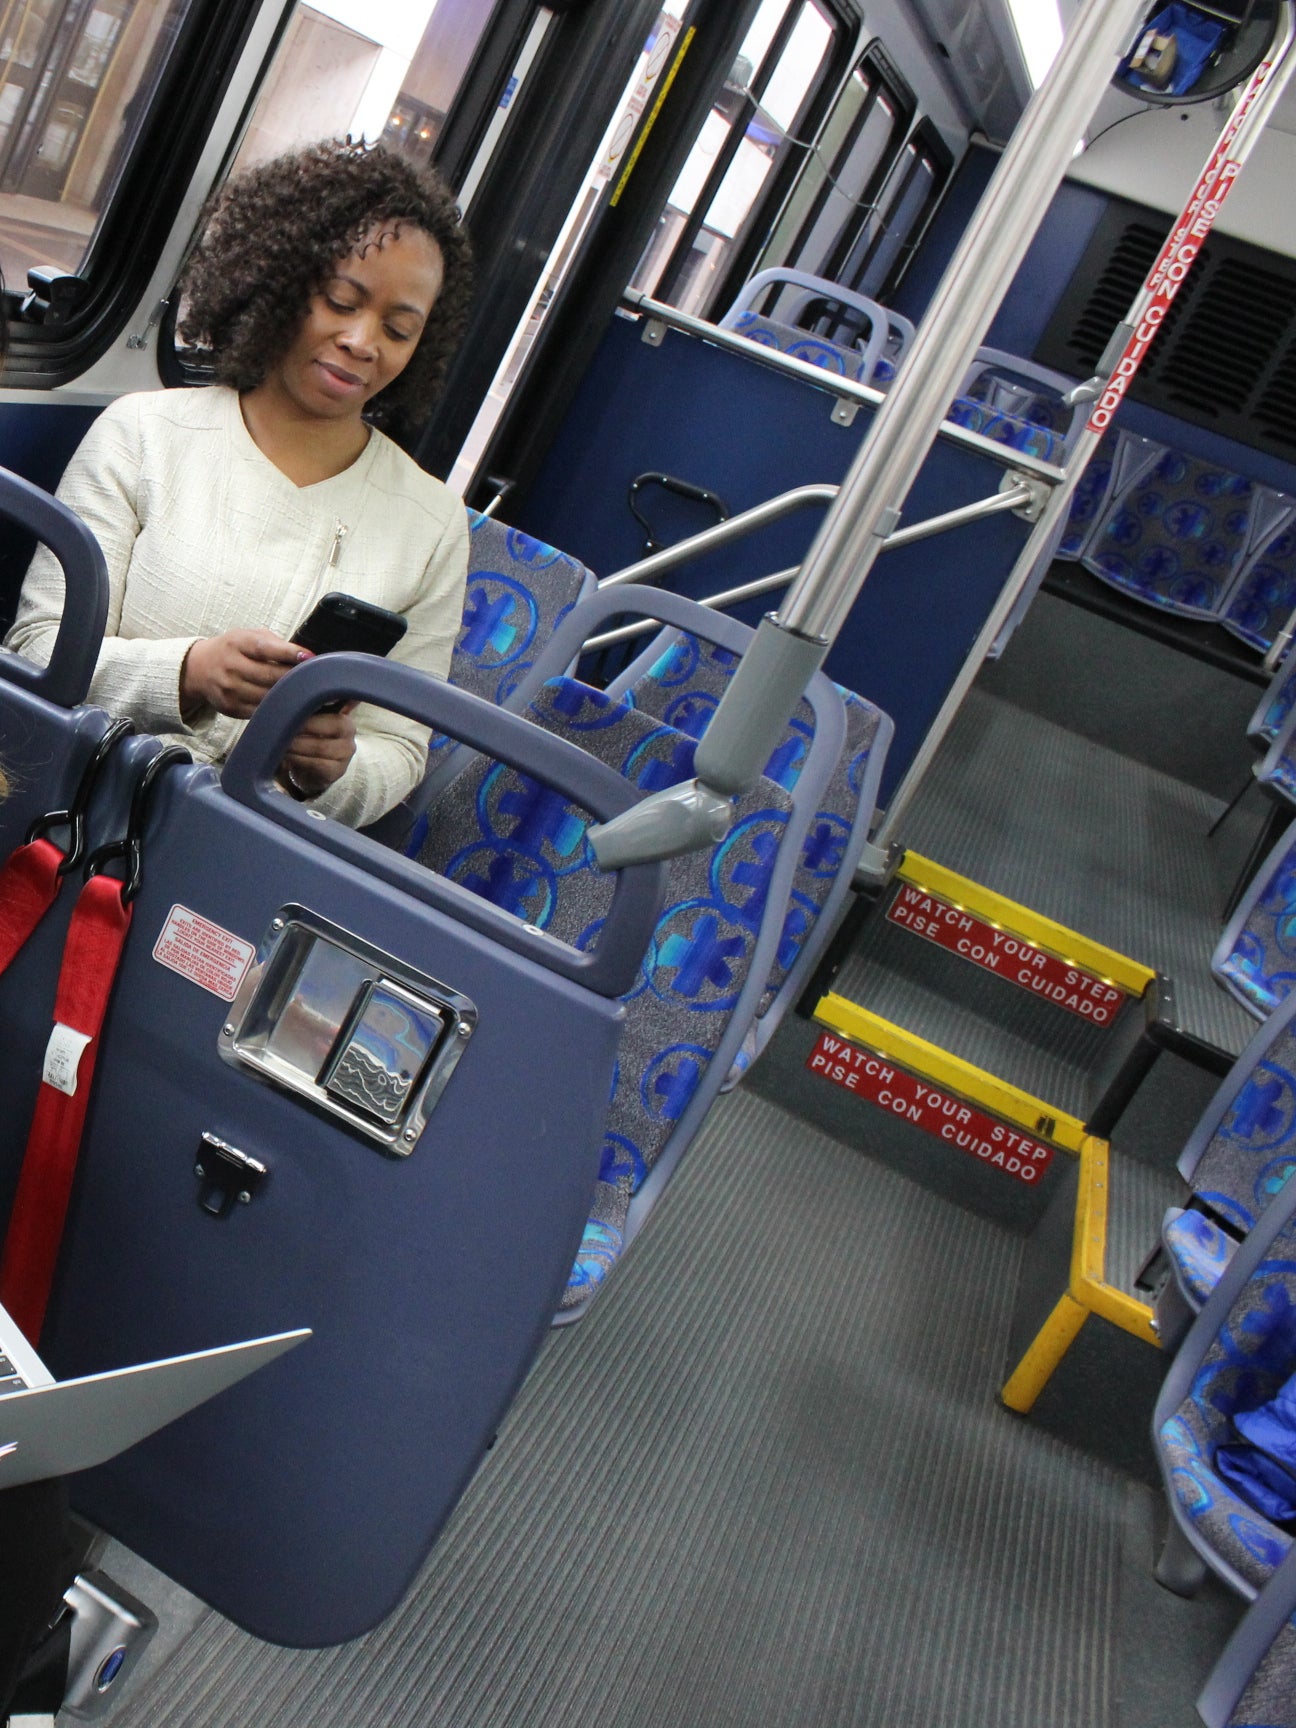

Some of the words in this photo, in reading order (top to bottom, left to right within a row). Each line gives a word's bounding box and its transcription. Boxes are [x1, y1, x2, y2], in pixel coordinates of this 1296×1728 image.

[1150, 228, 1186, 287] STEP
[1190, 162, 1240, 239] PISE
[1158, 244, 1197, 300] CON
[1091, 306, 1164, 427] CUIDADO
[191, 918, 221, 937] EMERGENCY
[221, 935, 232, 944] EXIT
[894, 906, 940, 938] PISE
[957, 939, 1000, 968] CON
[1018, 969, 1108, 1024] CUIDADO
[905, 887, 973, 932] WATCH
[992, 933, 1046, 970] YOUR
[1064, 970, 1120, 1003] STEP
[811, 1055, 858, 1089] PISE
[878, 1091, 922, 1122] CON
[941, 1124, 1037, 1181] CUIDADO
[823, 1036, 894, 1084] WATCH
[915, 1085, 972, 1125] YOUR
[991, 1126, 1047, 1162] STEP
